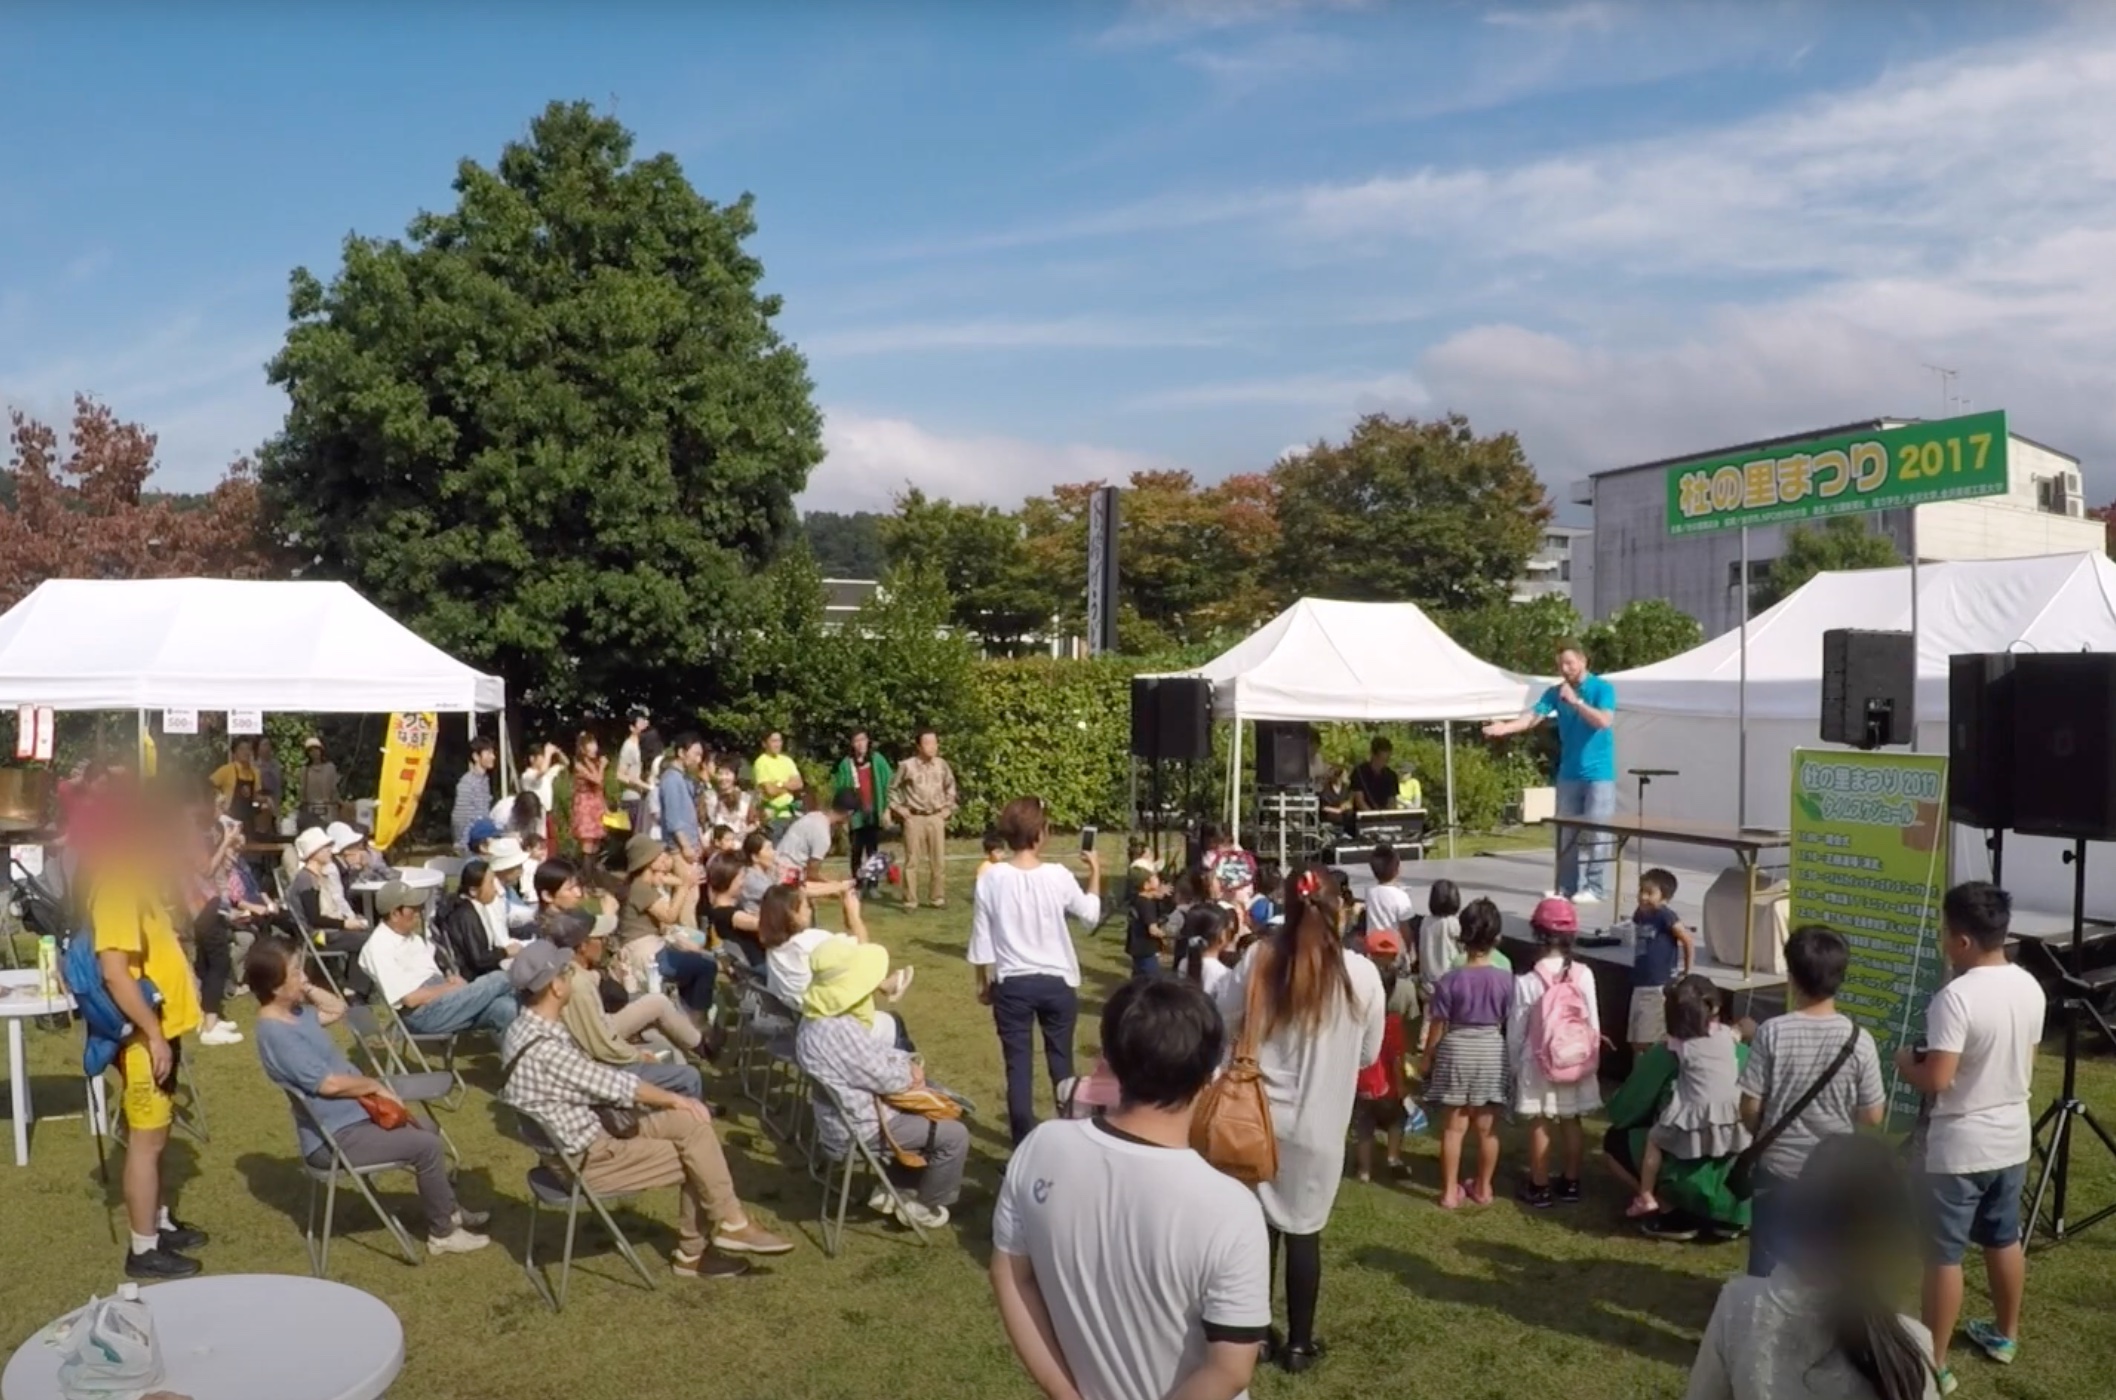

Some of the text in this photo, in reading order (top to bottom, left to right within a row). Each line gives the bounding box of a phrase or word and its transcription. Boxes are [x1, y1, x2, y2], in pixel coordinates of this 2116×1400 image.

[1680, 433, 1992, 517] 杜の里まつり 2017
[1803, 765, 1939, 798] 杜の里まつり 2017
[1823, 797, 1914, 825] タイムスケジュール
